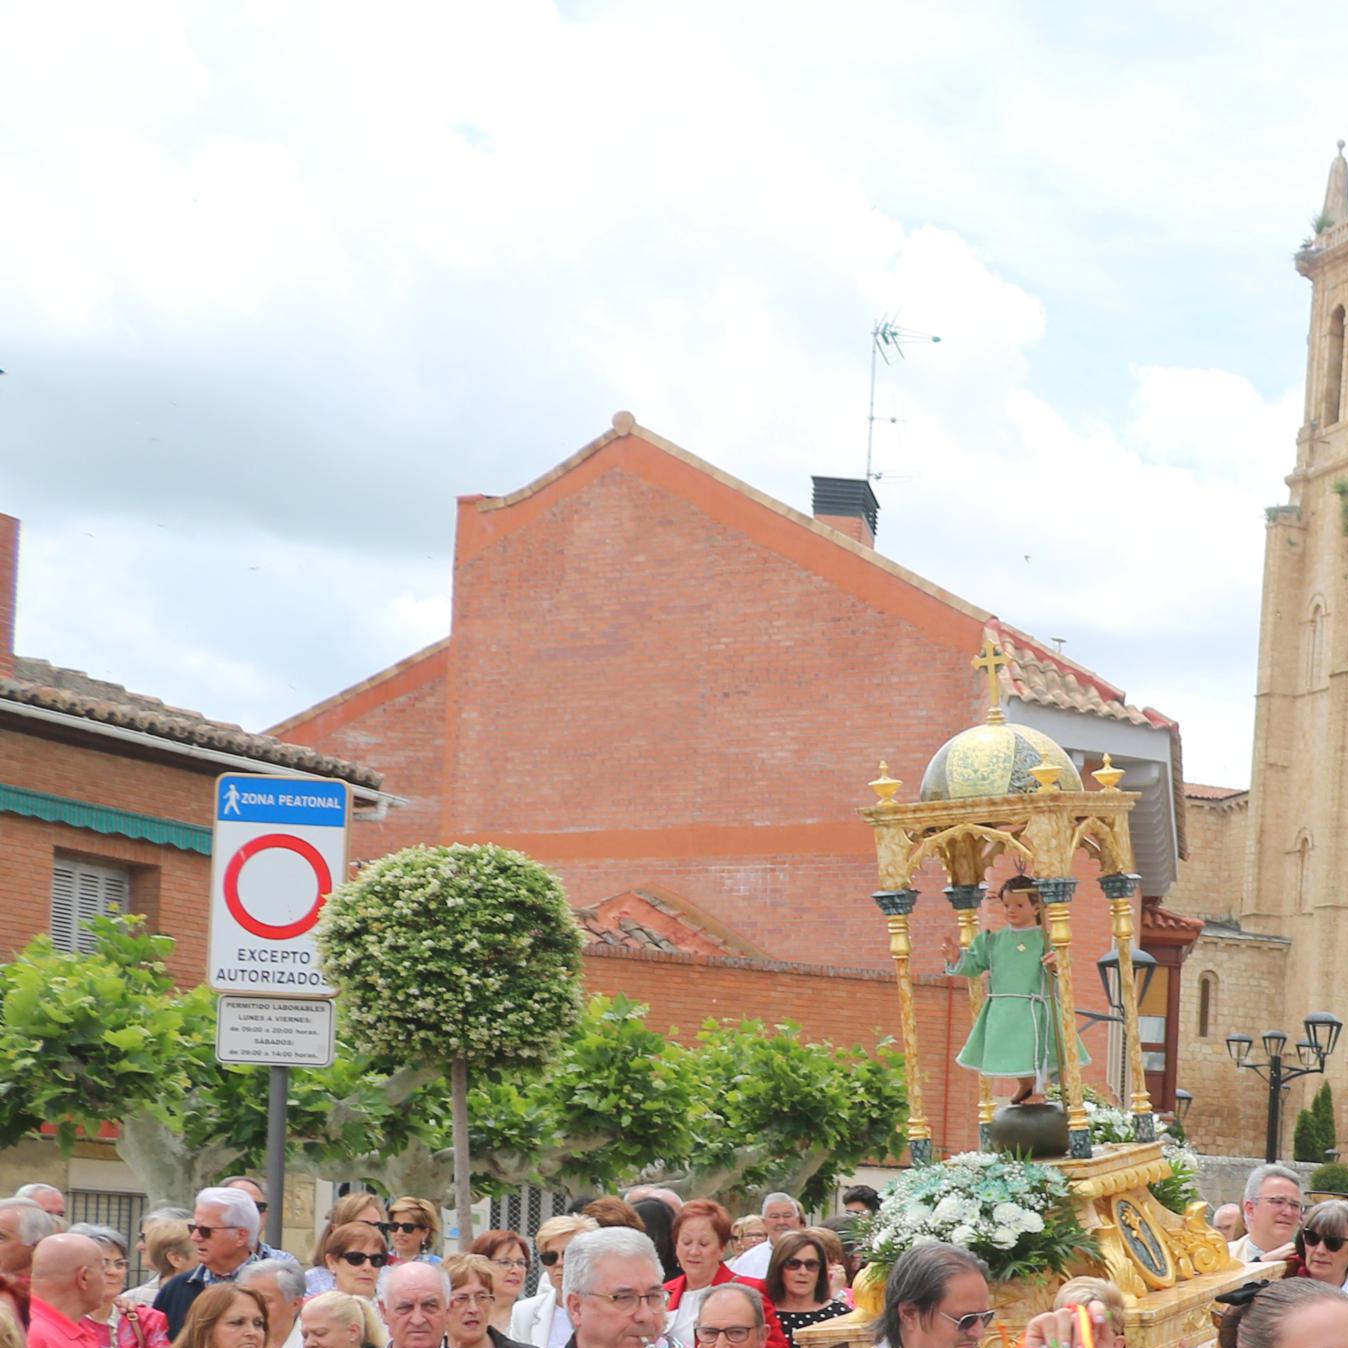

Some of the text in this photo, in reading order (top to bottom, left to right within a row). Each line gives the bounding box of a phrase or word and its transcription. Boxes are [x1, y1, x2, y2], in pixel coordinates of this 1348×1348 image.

[240, 792, 342, 809] ZONA PEATONAL
[237, 948, 311, 964] EXCEPTO
[216, 968, 329, 986] AUTORIZADOS
[226, 1002, 325, 1012] PERMITIDO LABORABLES
